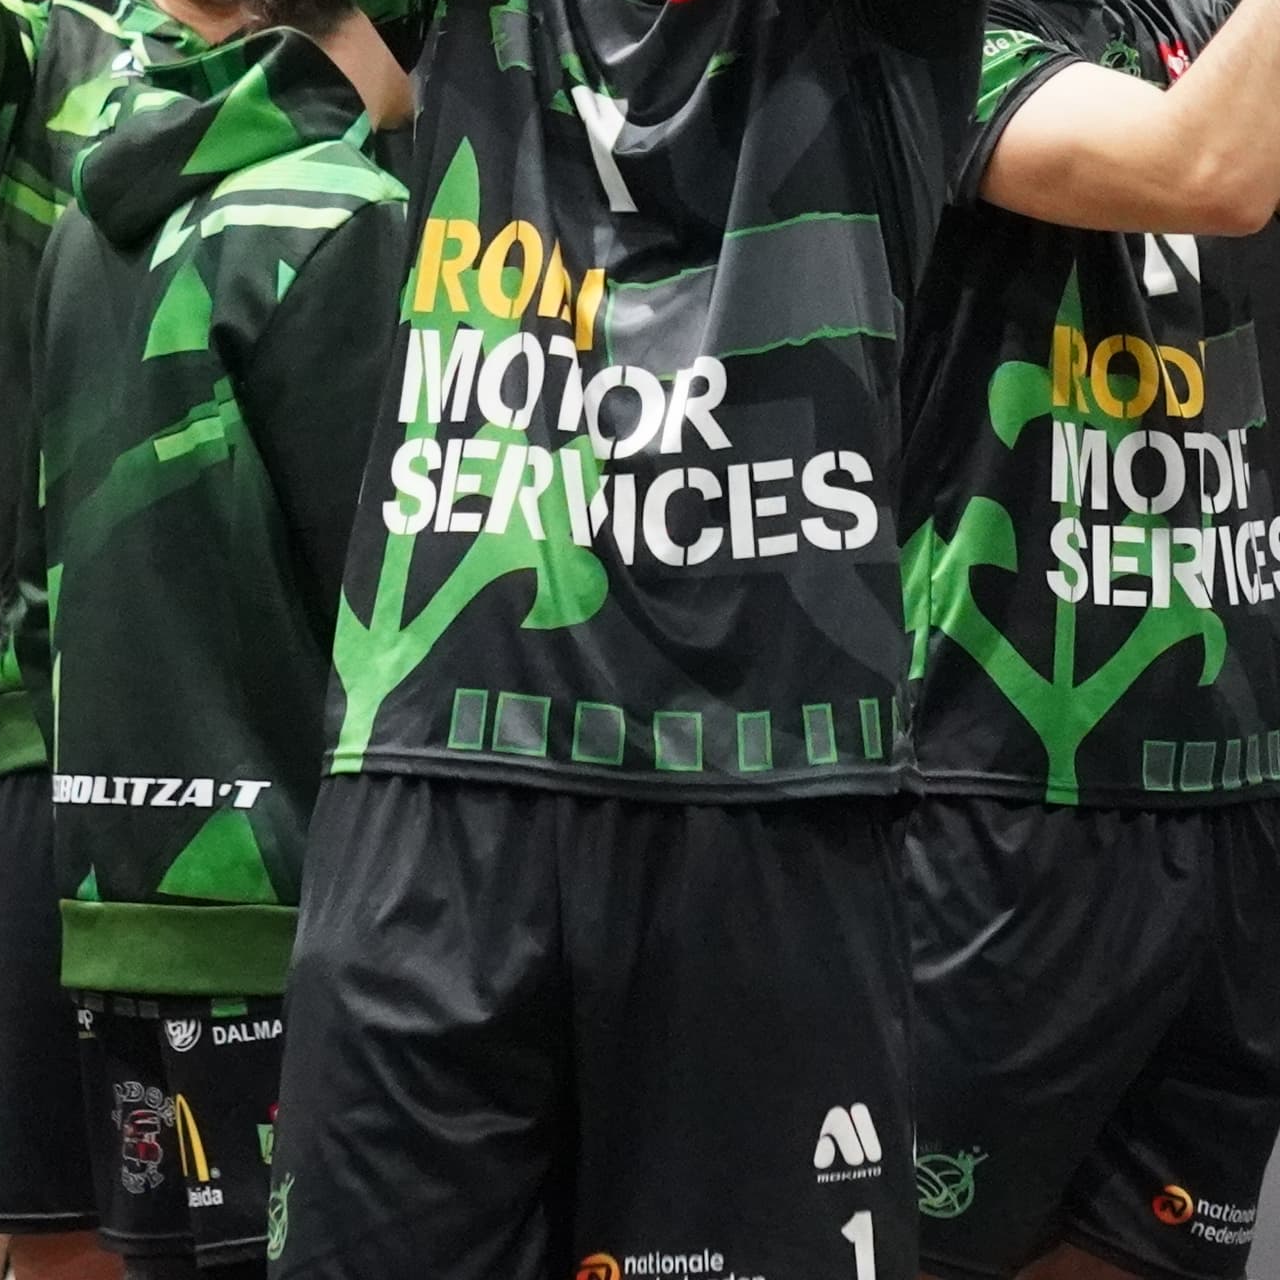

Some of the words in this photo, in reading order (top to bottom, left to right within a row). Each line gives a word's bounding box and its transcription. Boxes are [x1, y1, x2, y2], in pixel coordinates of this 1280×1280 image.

[397, 328, 731, 461] MOTOR
[1051, 324, 1207, 419] ROD
[382, 450, 879, 567] SERVICES
[624, 1248, 724, 1275] nationale
[840, 1210, 876, 1280] 1
